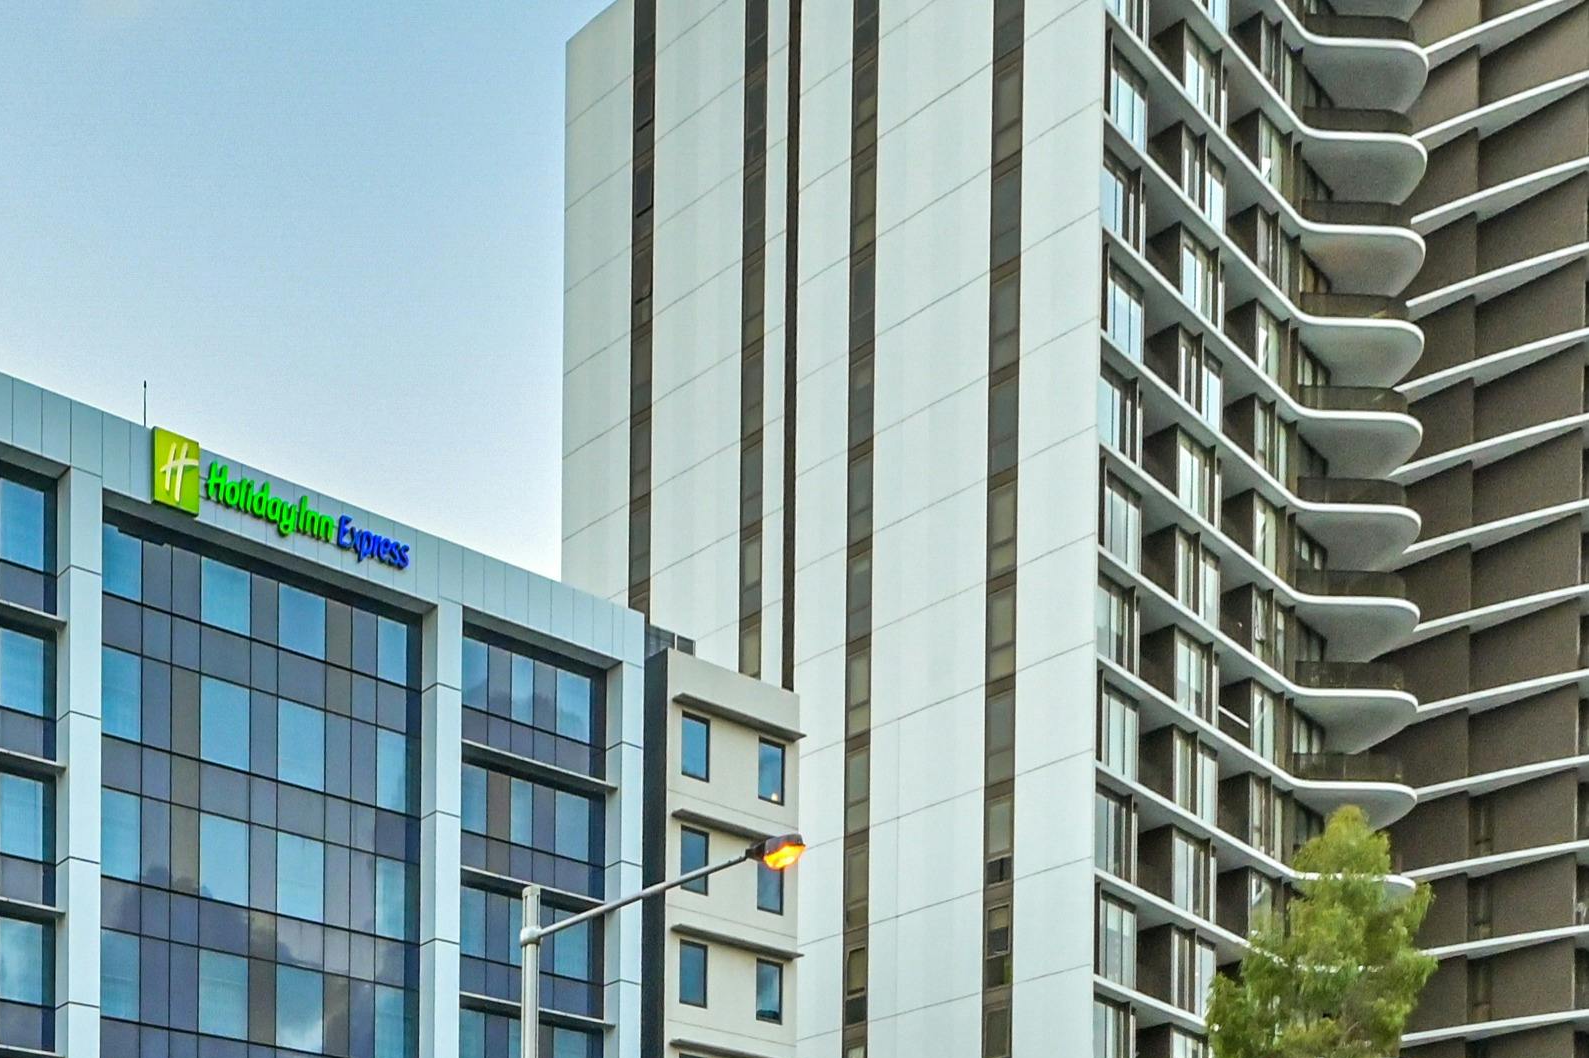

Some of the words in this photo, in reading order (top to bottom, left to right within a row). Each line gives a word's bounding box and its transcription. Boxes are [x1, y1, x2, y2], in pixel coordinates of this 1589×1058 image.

[207, 460, 296, 537] Holiday
[297, 496, 334, 543] Inn
[337, 515, 410, 570] Express
